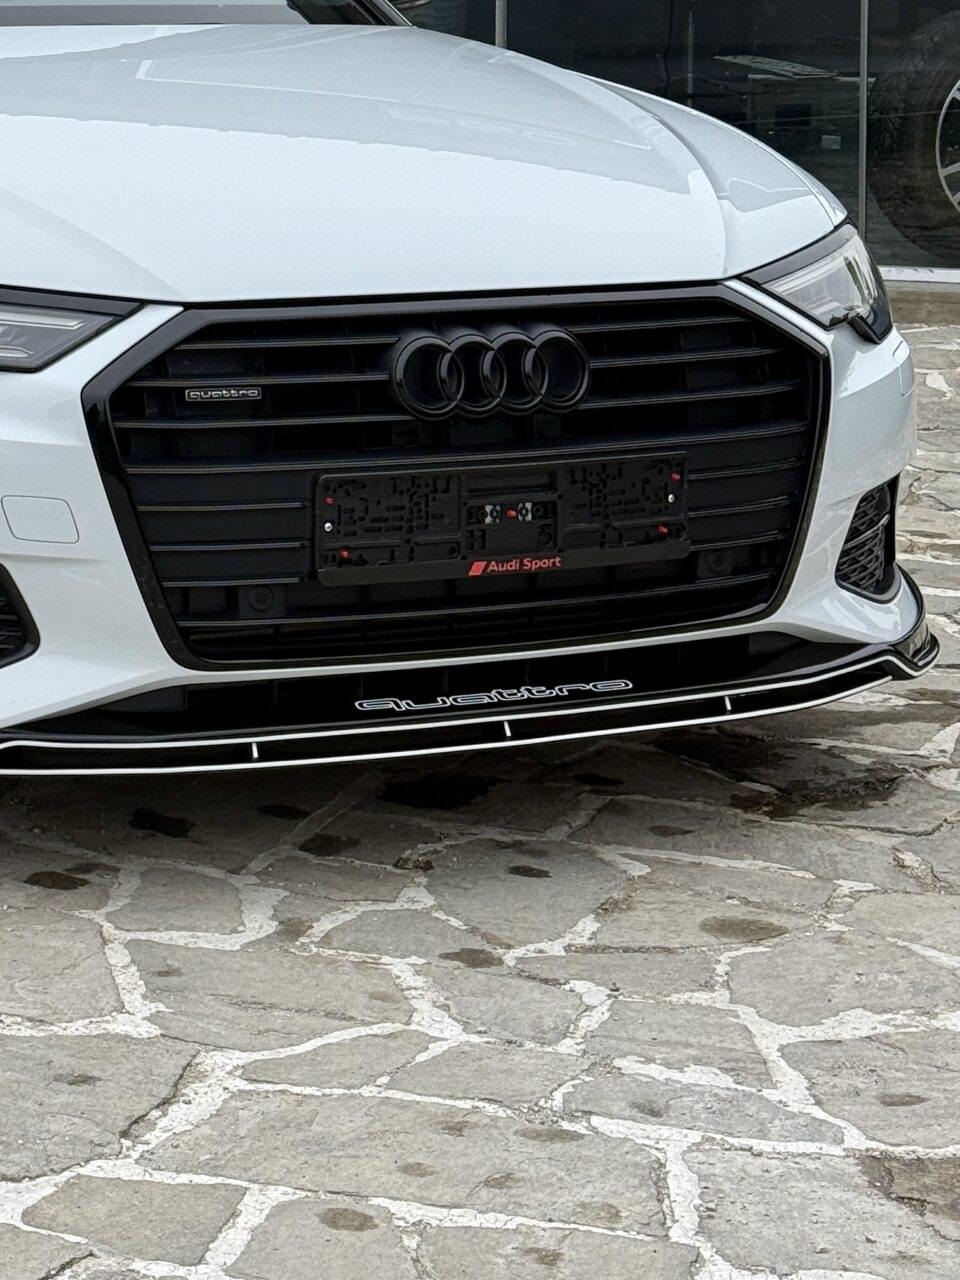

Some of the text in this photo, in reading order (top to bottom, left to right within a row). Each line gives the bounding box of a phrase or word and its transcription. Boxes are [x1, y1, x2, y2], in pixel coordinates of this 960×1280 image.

[188, 389, 259, 399] quattro
[487, 556, 562, 572] Audi Sport
[354, 679, 633, 712] quattro
